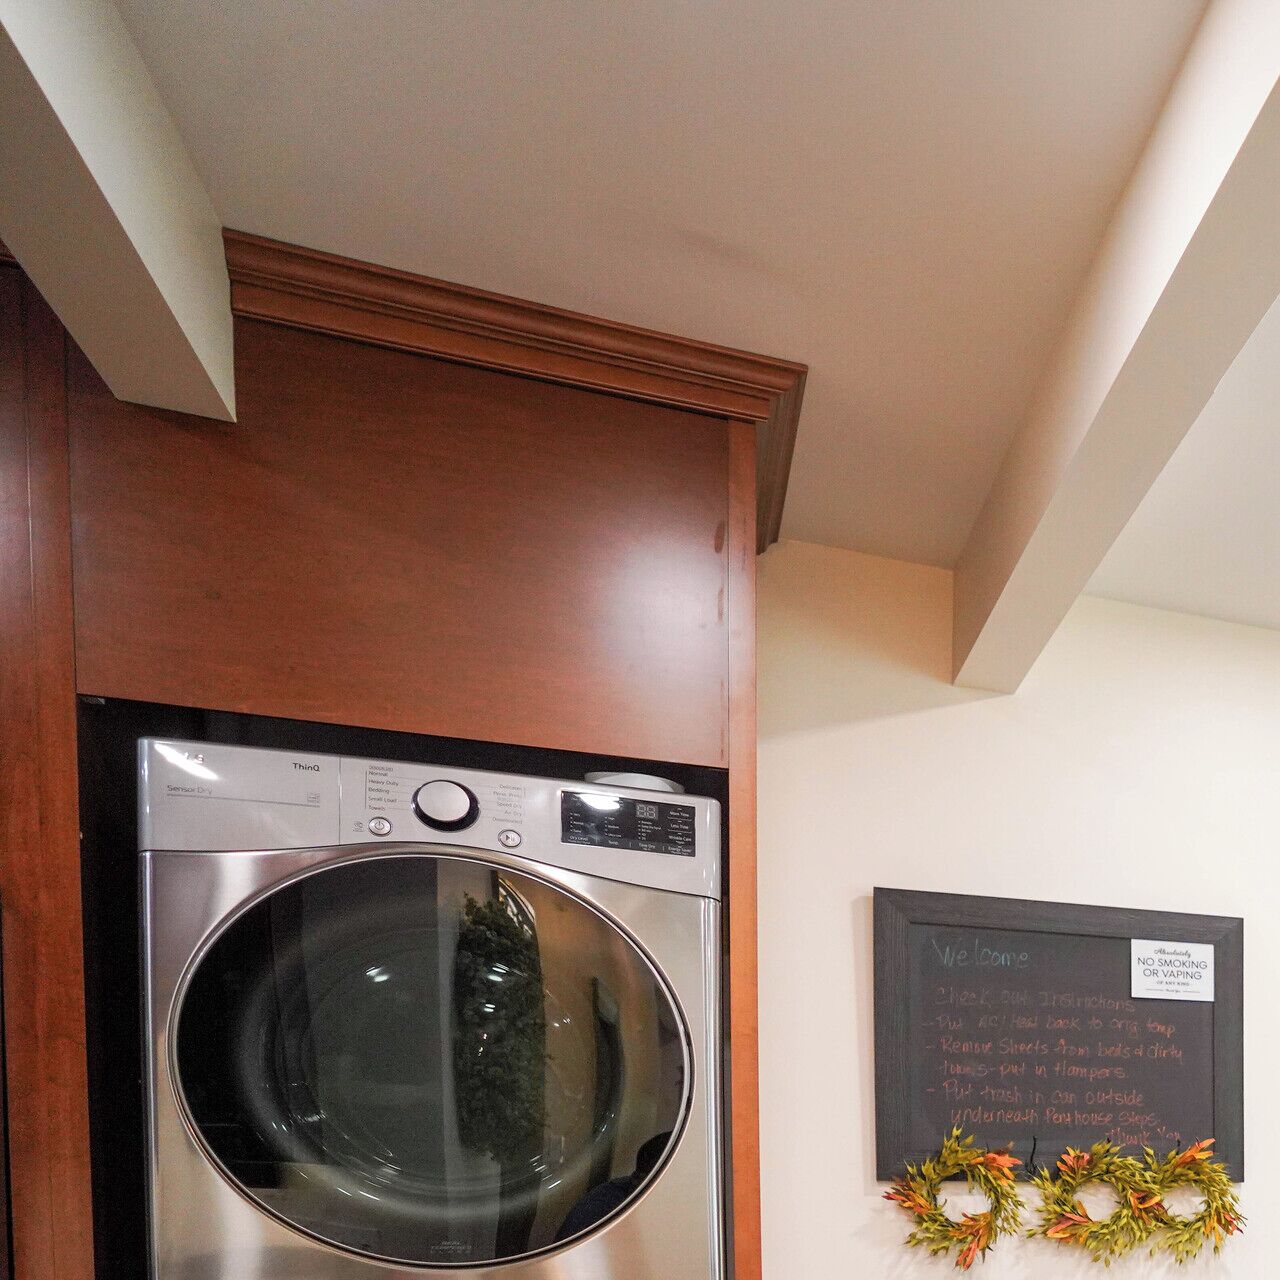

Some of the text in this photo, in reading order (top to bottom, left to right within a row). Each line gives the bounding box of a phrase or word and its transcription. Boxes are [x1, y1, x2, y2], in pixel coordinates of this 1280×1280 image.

[292, 762, 320, 772] ThinQ
[931, 938, 1030, 970] Welcome
[1153, 948, 1191, 958] Absolutely
[1137, 957, 1208, 970] NO SMOKING
[1143, 968, 1202, 980] OR VAPING
[1046, 1014, 1081, 1031] back
[1088, 1015, 1103, 1029] to
[1146, 1017, 1176, 1038] temp
[940, 1036, 993, 1054] Remove
[1054, 1038, 1090, 1057] from
[1097, 1042, 1131, 1060] beds
[1034, 1064, 1048, 1079] in
[942, 1079, 973, 1102] Put
[980, 1085, 1023, 1103] trash
[1029, 1089, 1045, 1104] in
[1051, 1089, 1077, 1105] can
[1084, 1088, 1144, 1107] outside
[951, 1106, 1039, 1126] underneath
